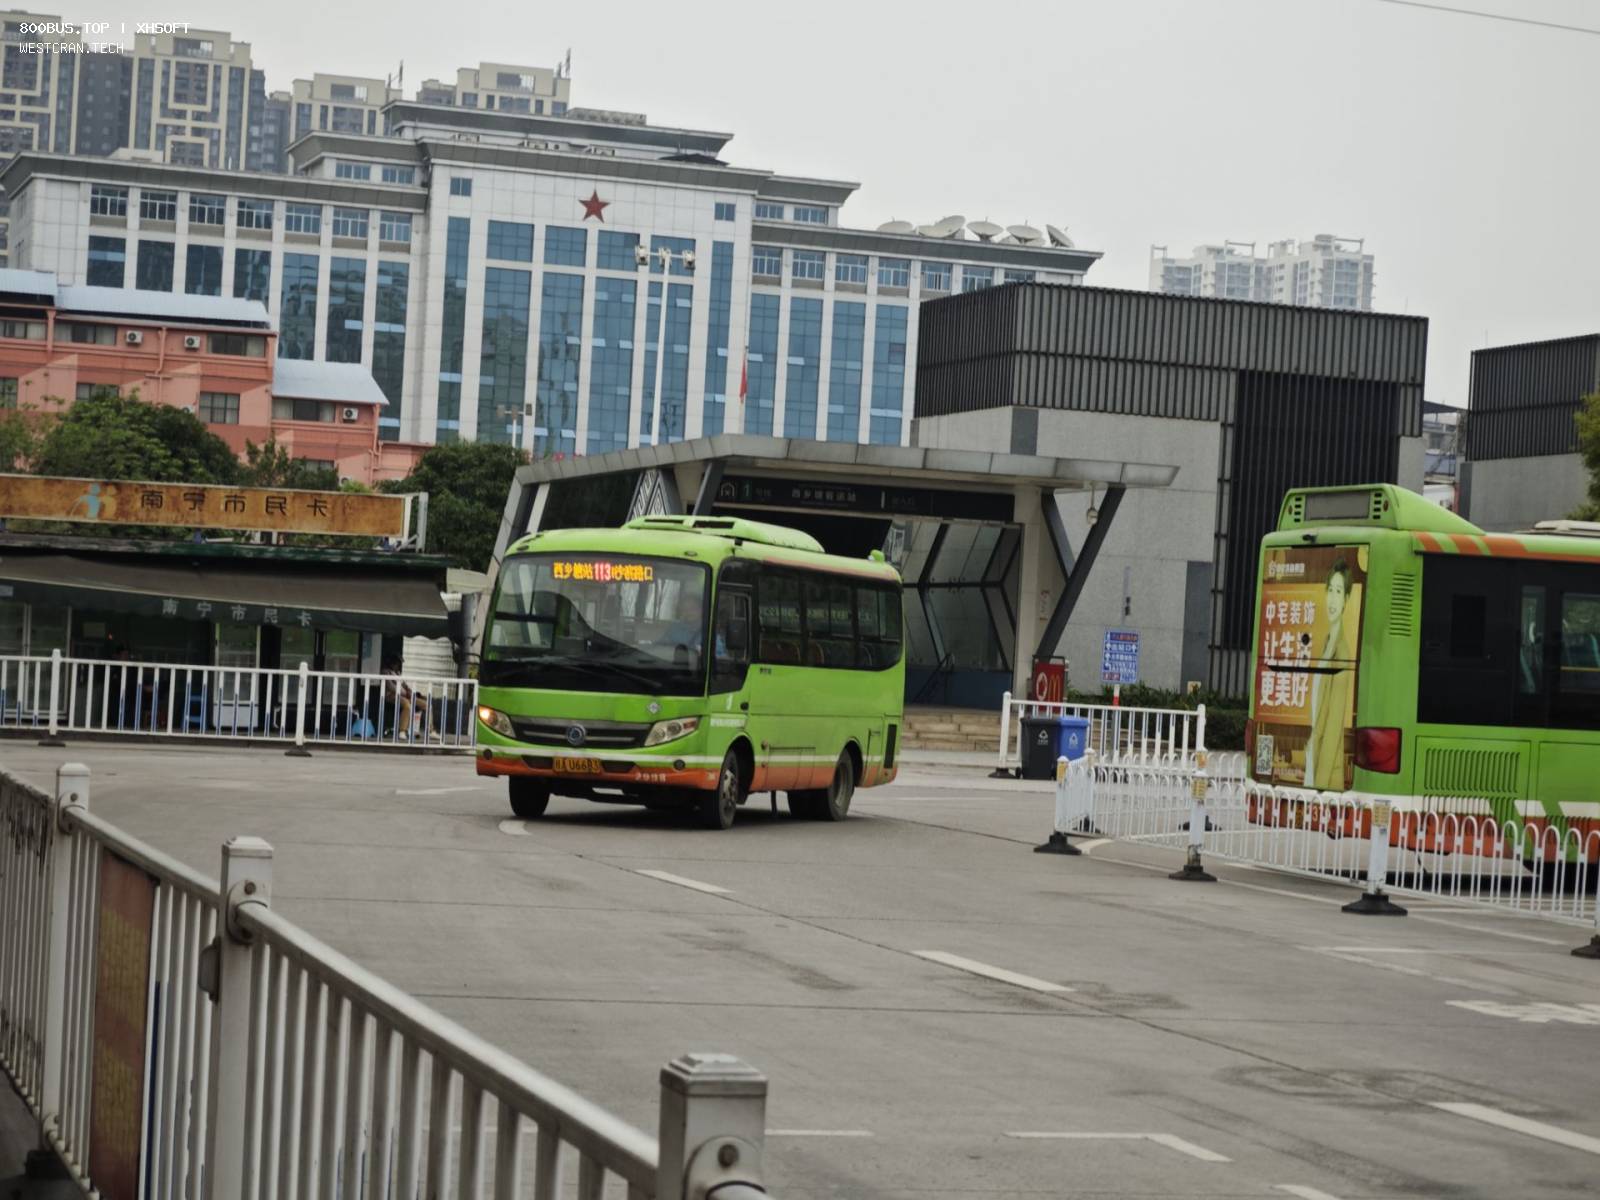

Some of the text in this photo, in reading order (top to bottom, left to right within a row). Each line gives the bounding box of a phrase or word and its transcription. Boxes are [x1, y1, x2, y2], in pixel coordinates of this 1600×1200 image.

[140, 488, 329, 518] 南宁市民卡
[594, 562, 611, 582] 113
[162, 598, 312, 627] 南宁市民卡
[1265, 600, 1316, 626] 中宅装饰
[1263, 631, 1313, 667] 让生活
[1259, 671, 1309, 709] 更美好
